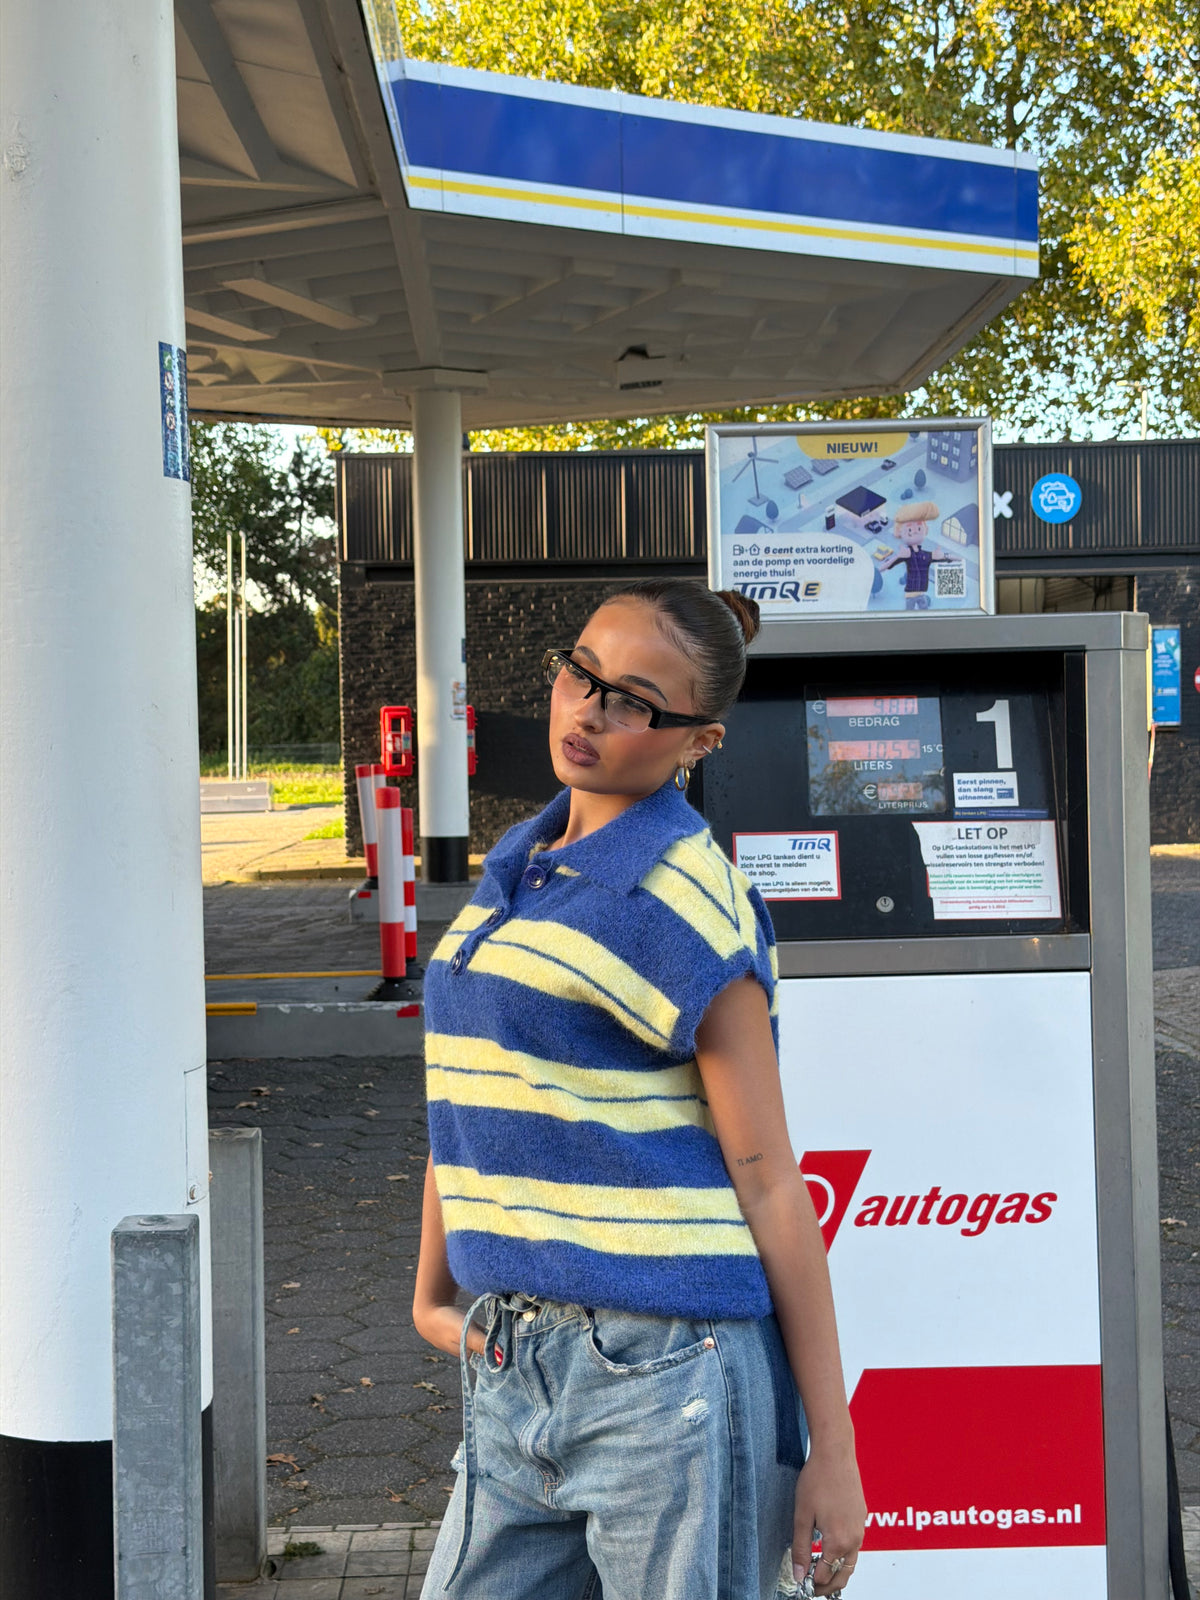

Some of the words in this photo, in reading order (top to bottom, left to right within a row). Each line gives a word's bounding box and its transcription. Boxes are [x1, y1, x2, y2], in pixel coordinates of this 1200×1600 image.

[826, 442, 879, 454] NIEUW!
[764, 546, 771, 554] 6
[772, 546, 794, 554] cent
[821, 545, 853, 554] korting
[752, 558, 763, 566] de
[766, 558, 791, 567] pomp
[806, 556, 854, 566] voordelige
[734, 569, 768, 578] energie
[770, 569, 795, 577] thuis!
[849, 716, 900, 727] BEDRAG
[976, 699, 1013, 769] 1
[854, 760, 893, 770] LITERS
[878, 801, 928, 809] LITERPRIJS
[958, 827, 982, 840] LET
[987, 827, 1008, 840] OP
[788, 838, 831, 852] TinQ
[985, 860, 1013, 868] strengste
[758, 870, 777, 878] shop.
[854, 1186, 1058, 1237] autogas
